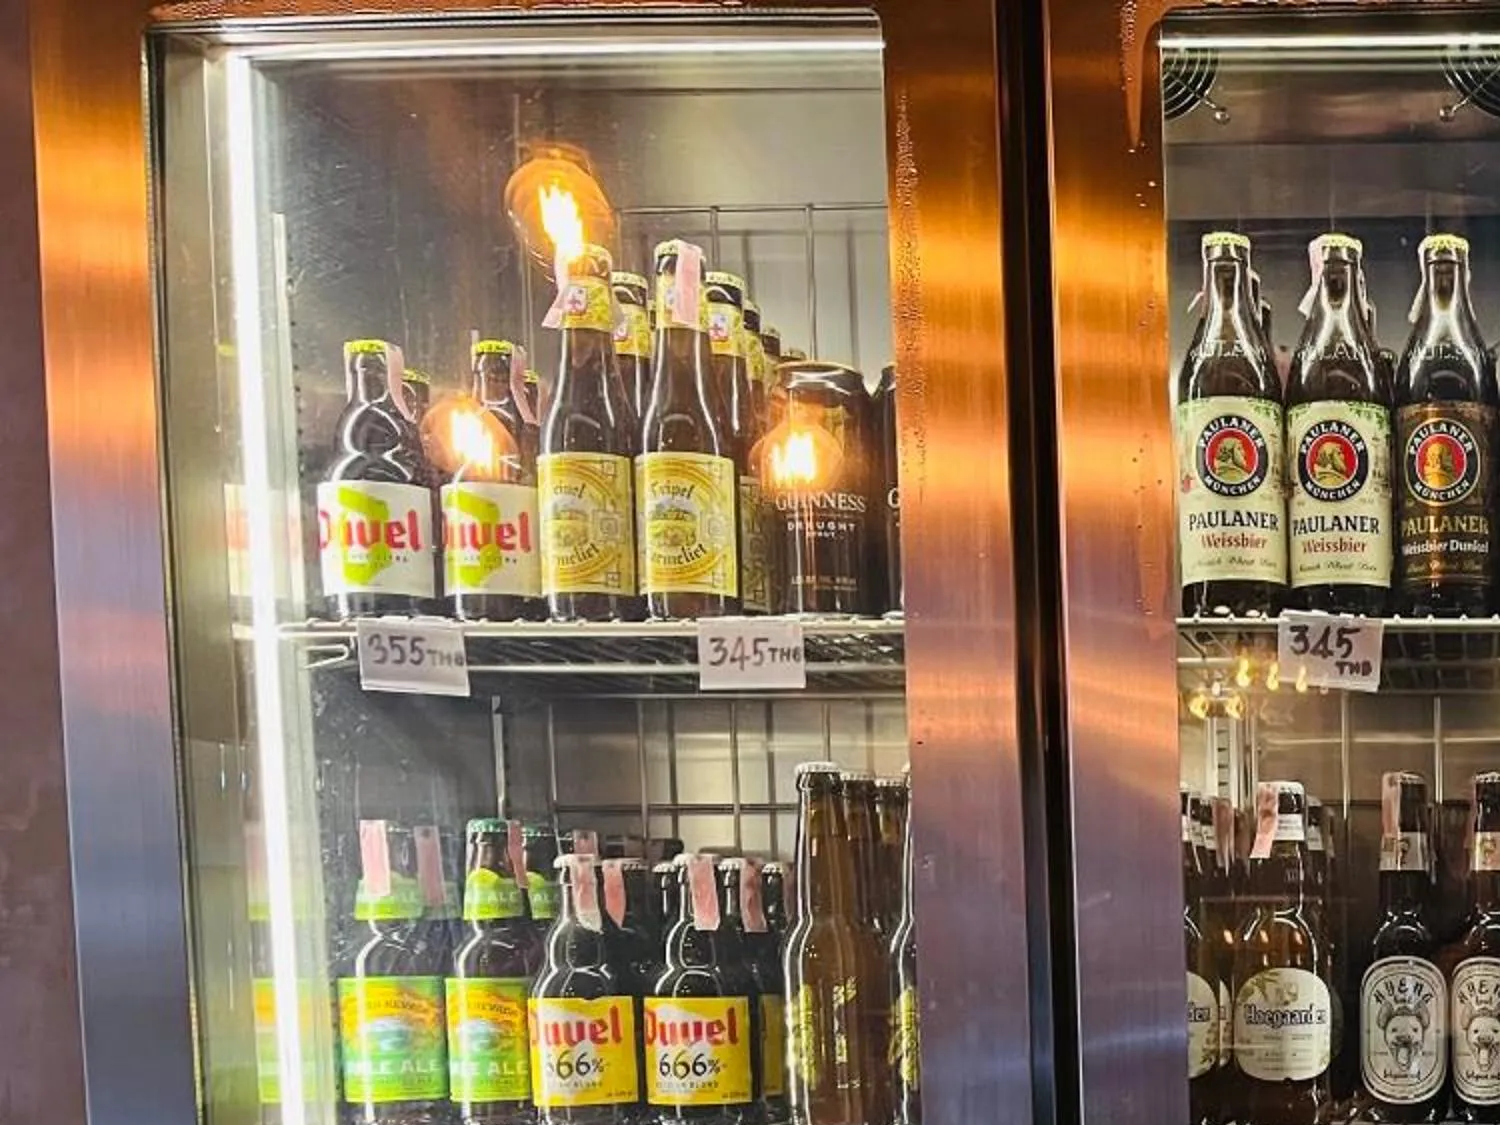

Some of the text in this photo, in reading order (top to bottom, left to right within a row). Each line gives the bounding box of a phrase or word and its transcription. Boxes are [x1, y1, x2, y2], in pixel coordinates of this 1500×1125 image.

[1302, 421, 1366, 454] PAULANER
[1409, 422, 1473, 455] PAULANER
[775, 490, 867, 513] GUINNESS
[1188, 510, 1280, 532] PAULANER
[1293, 515, 1380, 537] PAULANER
[1289, 624, 1362, 660] 345
